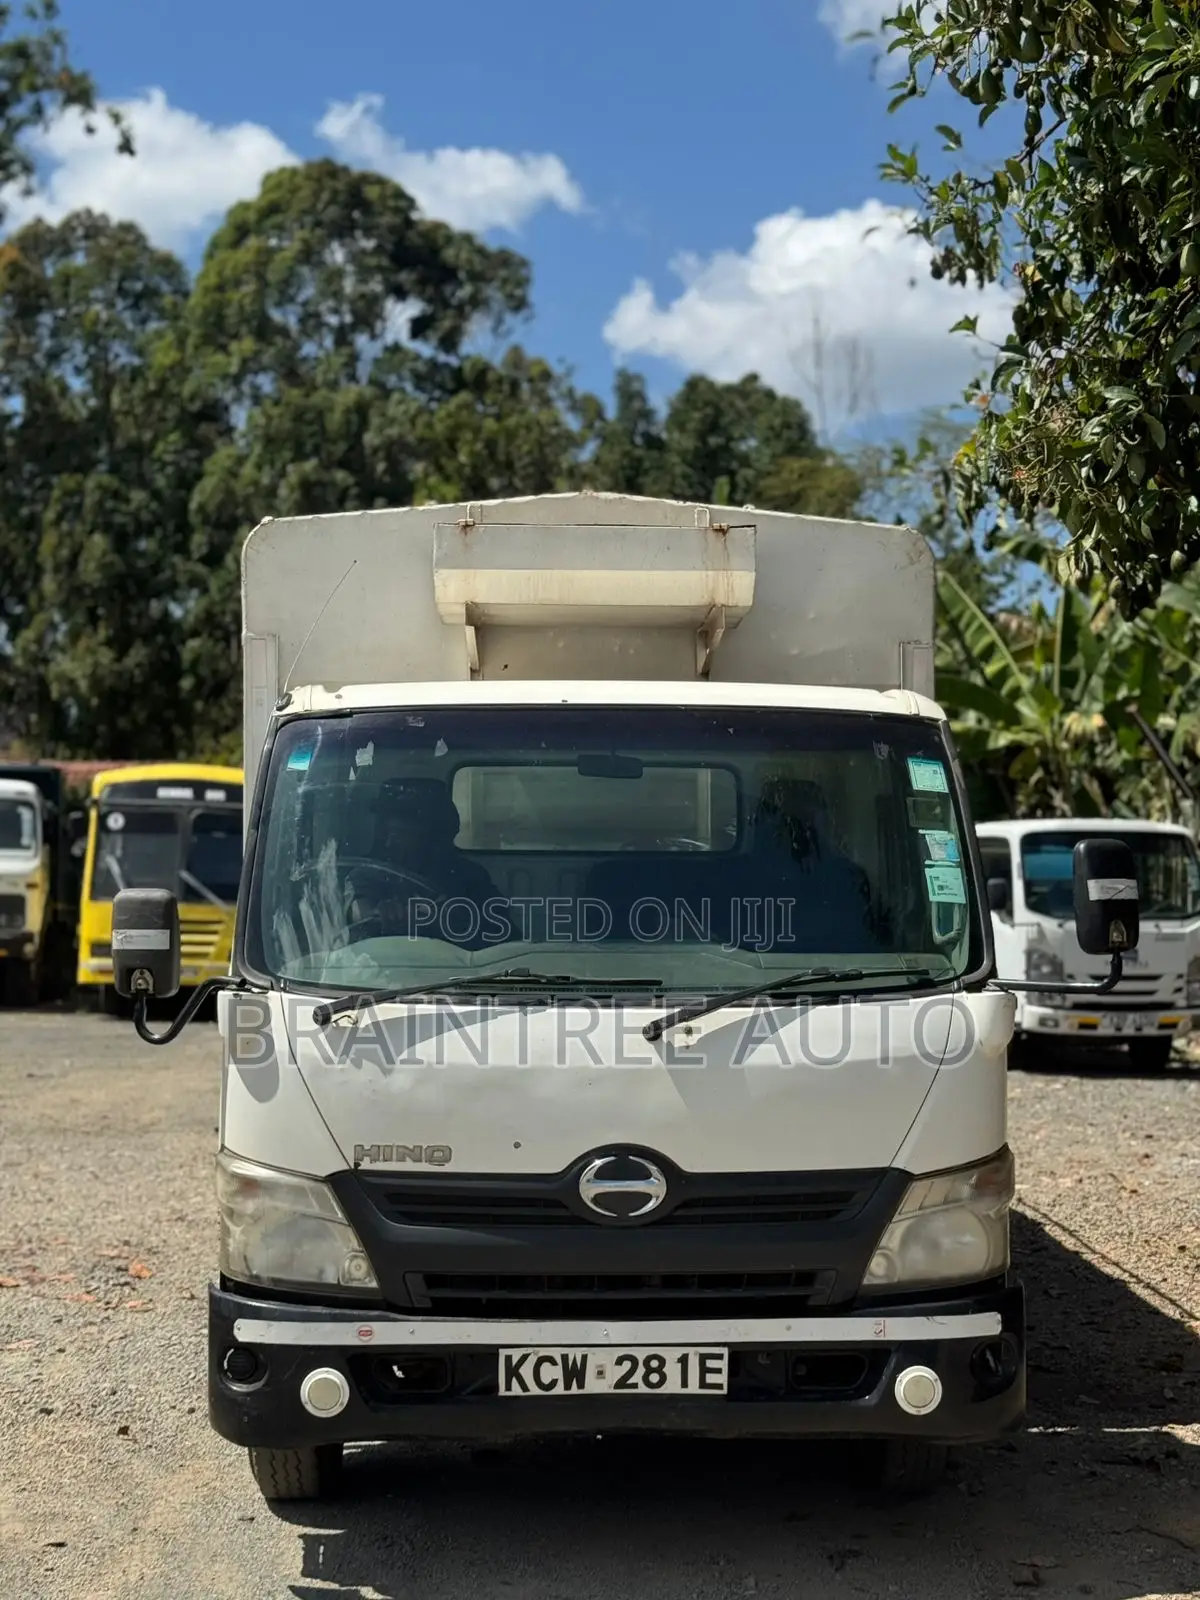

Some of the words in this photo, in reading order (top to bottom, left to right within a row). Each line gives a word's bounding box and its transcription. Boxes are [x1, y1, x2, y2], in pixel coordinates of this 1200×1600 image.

[353, 1144, 452, 1165] HINO
[504, 1353, 588, 1392] KCW
[613, 1353, 724, 1390] 281E
